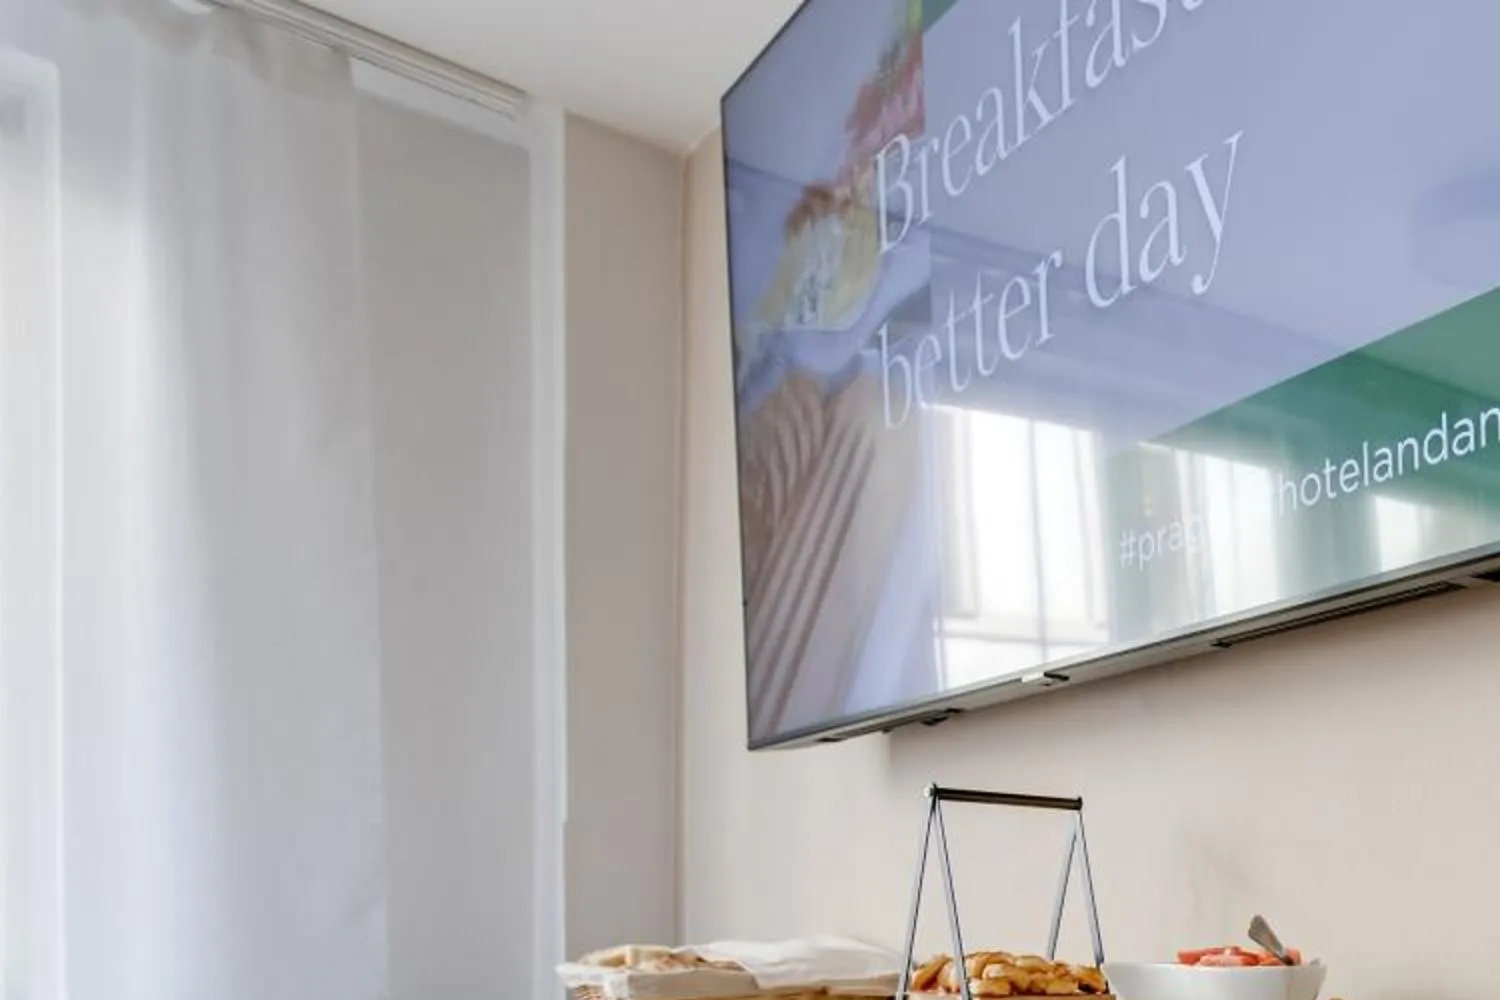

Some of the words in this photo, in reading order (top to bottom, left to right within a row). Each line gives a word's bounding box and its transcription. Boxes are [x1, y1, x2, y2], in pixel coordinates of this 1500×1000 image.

[876, 0, 1202, 254] Breakfas
[878, 250, 1063, 430] better
[1085, 130, 1244, 308] day
